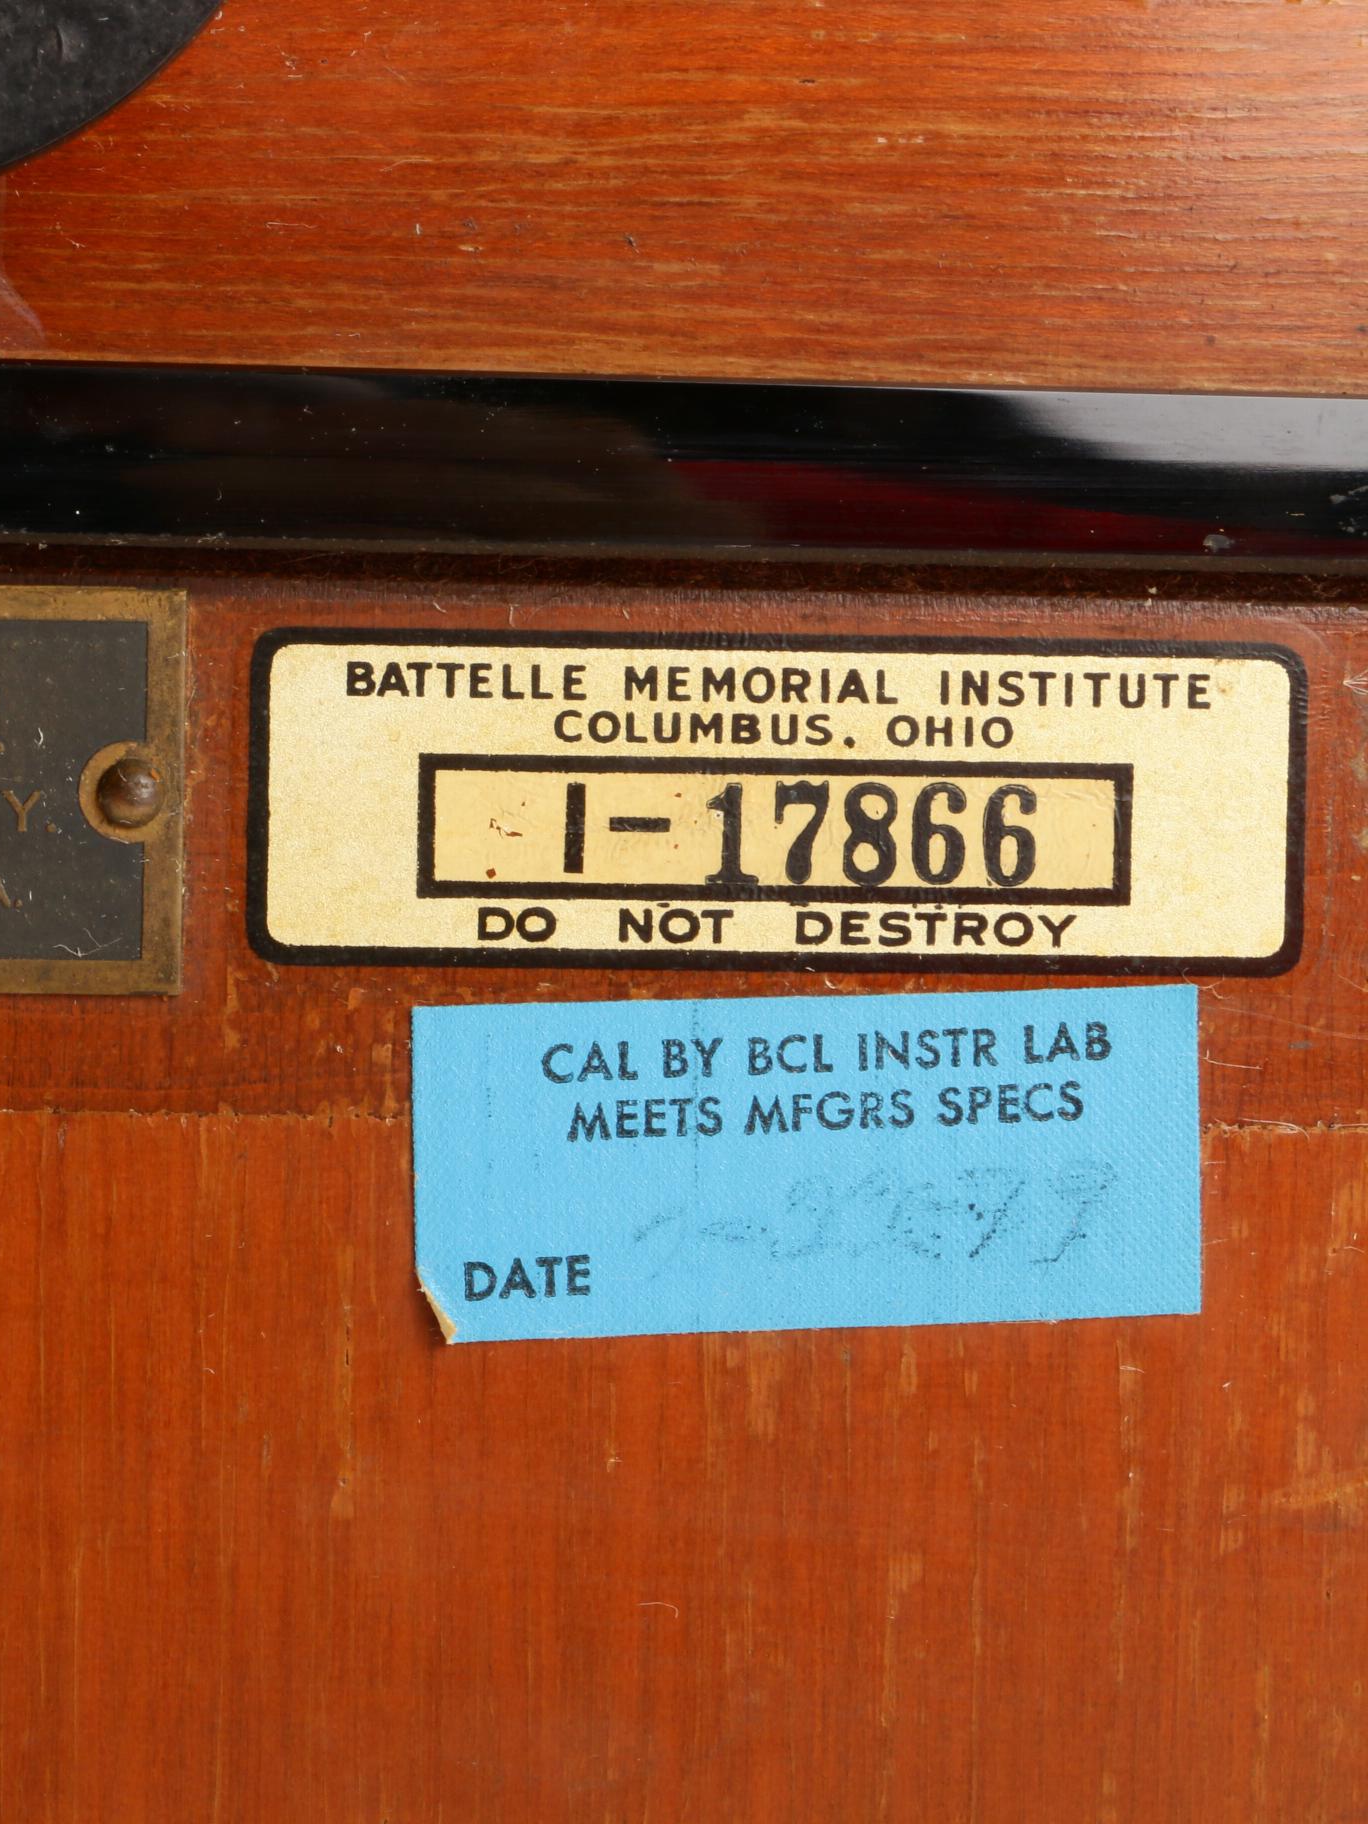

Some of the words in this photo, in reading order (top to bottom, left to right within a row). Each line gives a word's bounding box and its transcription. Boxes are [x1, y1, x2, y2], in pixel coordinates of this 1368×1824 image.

[345, 660, 588, 702] BATTELLE
[624, 665, 898, 704] MEMORIAL
[940, 669, 1212, 710] INSTITUTE
[885, 715, 1015, 749] OHIO
[476, 906, 557, 946] DO
[618, 908, 736, 946] NOT
[795, 907, 1078, 950] DESTROY
[540, 1042, 639, 1086] CAL
[662, 1038, 724, 1080] BY
[747, 1035, 834, 1077] BCL
[858, 1028, 998, 1070] INSTR
[1023, 1022, 1114, 1063] LAB
[566, 1096, 724, 1144] MEETS
[743, 1089, 916, 1137] MFGRS
[937, 1081, 1086, 1128] SPECS
[463, 1254, 592, 1303] DATE
